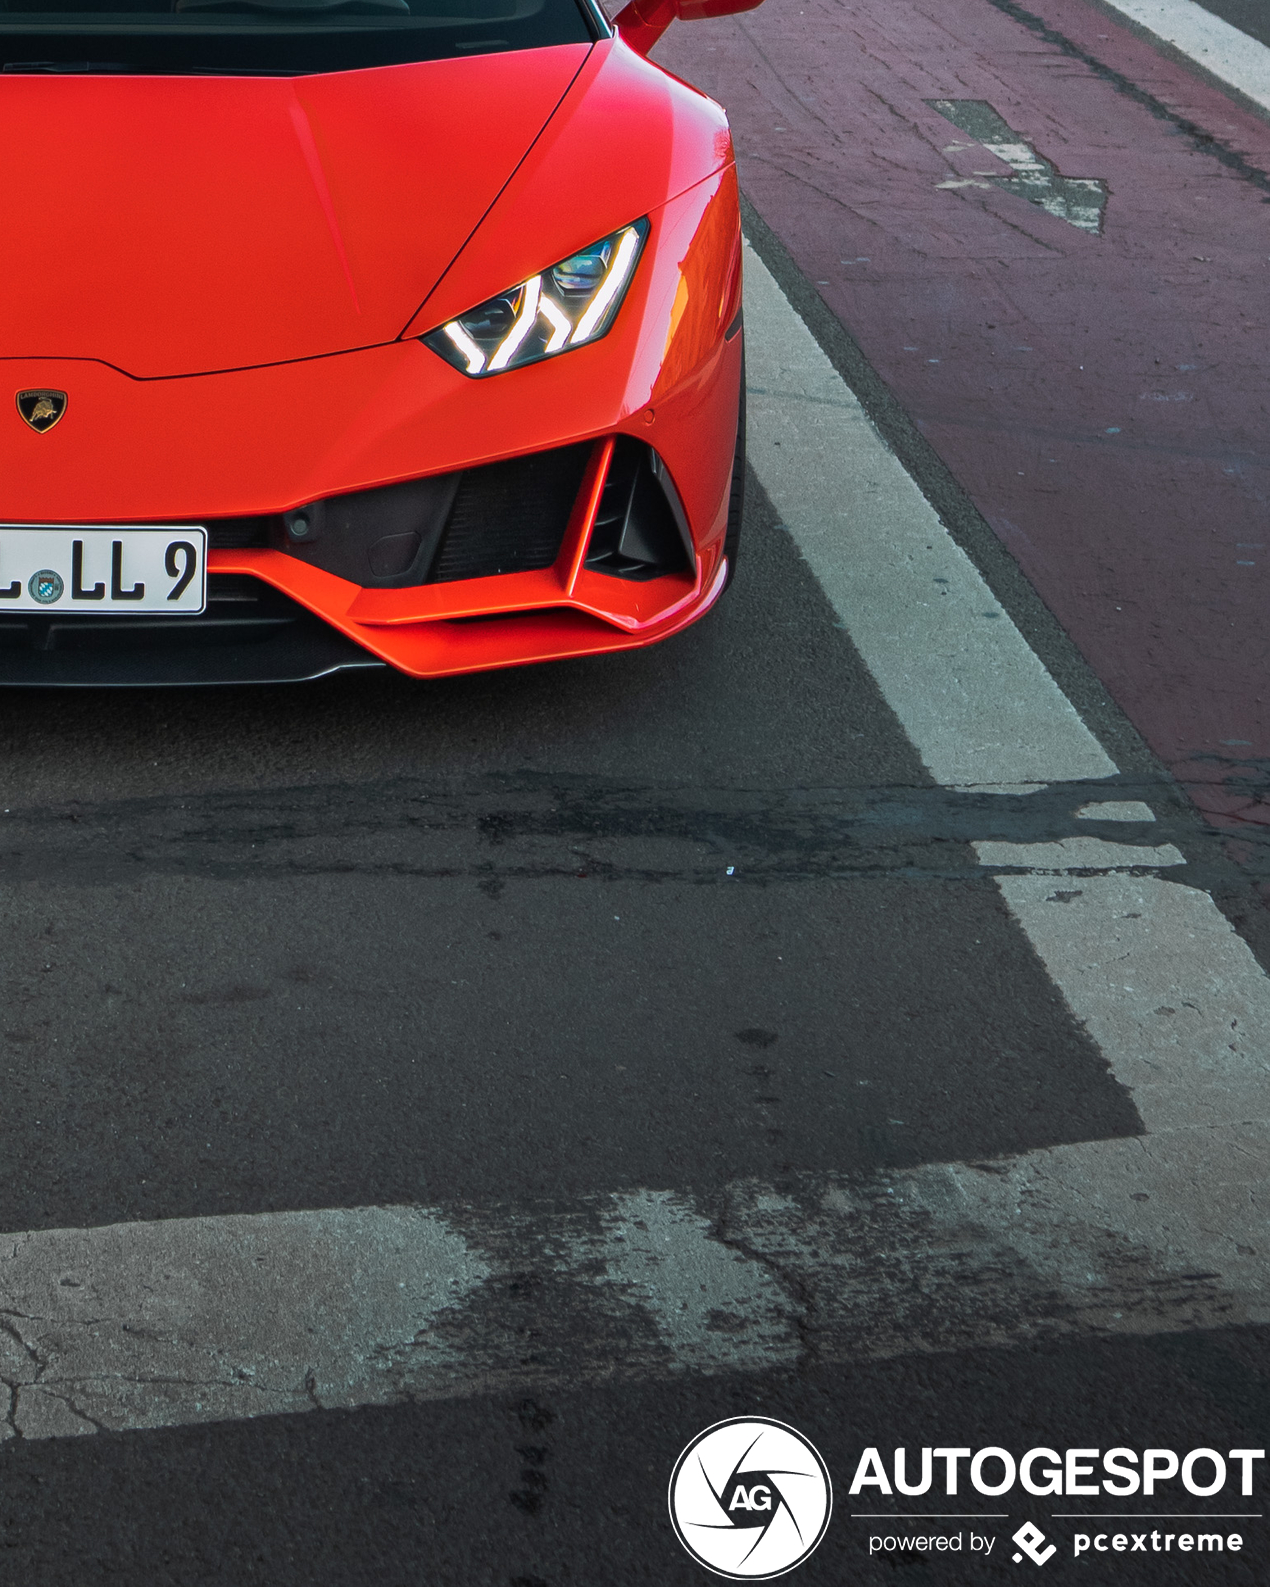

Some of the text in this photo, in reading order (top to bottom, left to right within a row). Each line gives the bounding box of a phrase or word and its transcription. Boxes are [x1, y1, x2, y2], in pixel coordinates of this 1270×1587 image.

[20, 391, 64, 400] LAMBORGHINI
[71, 539, 146, 601] LL
[164, 540, 198, 601] 9
